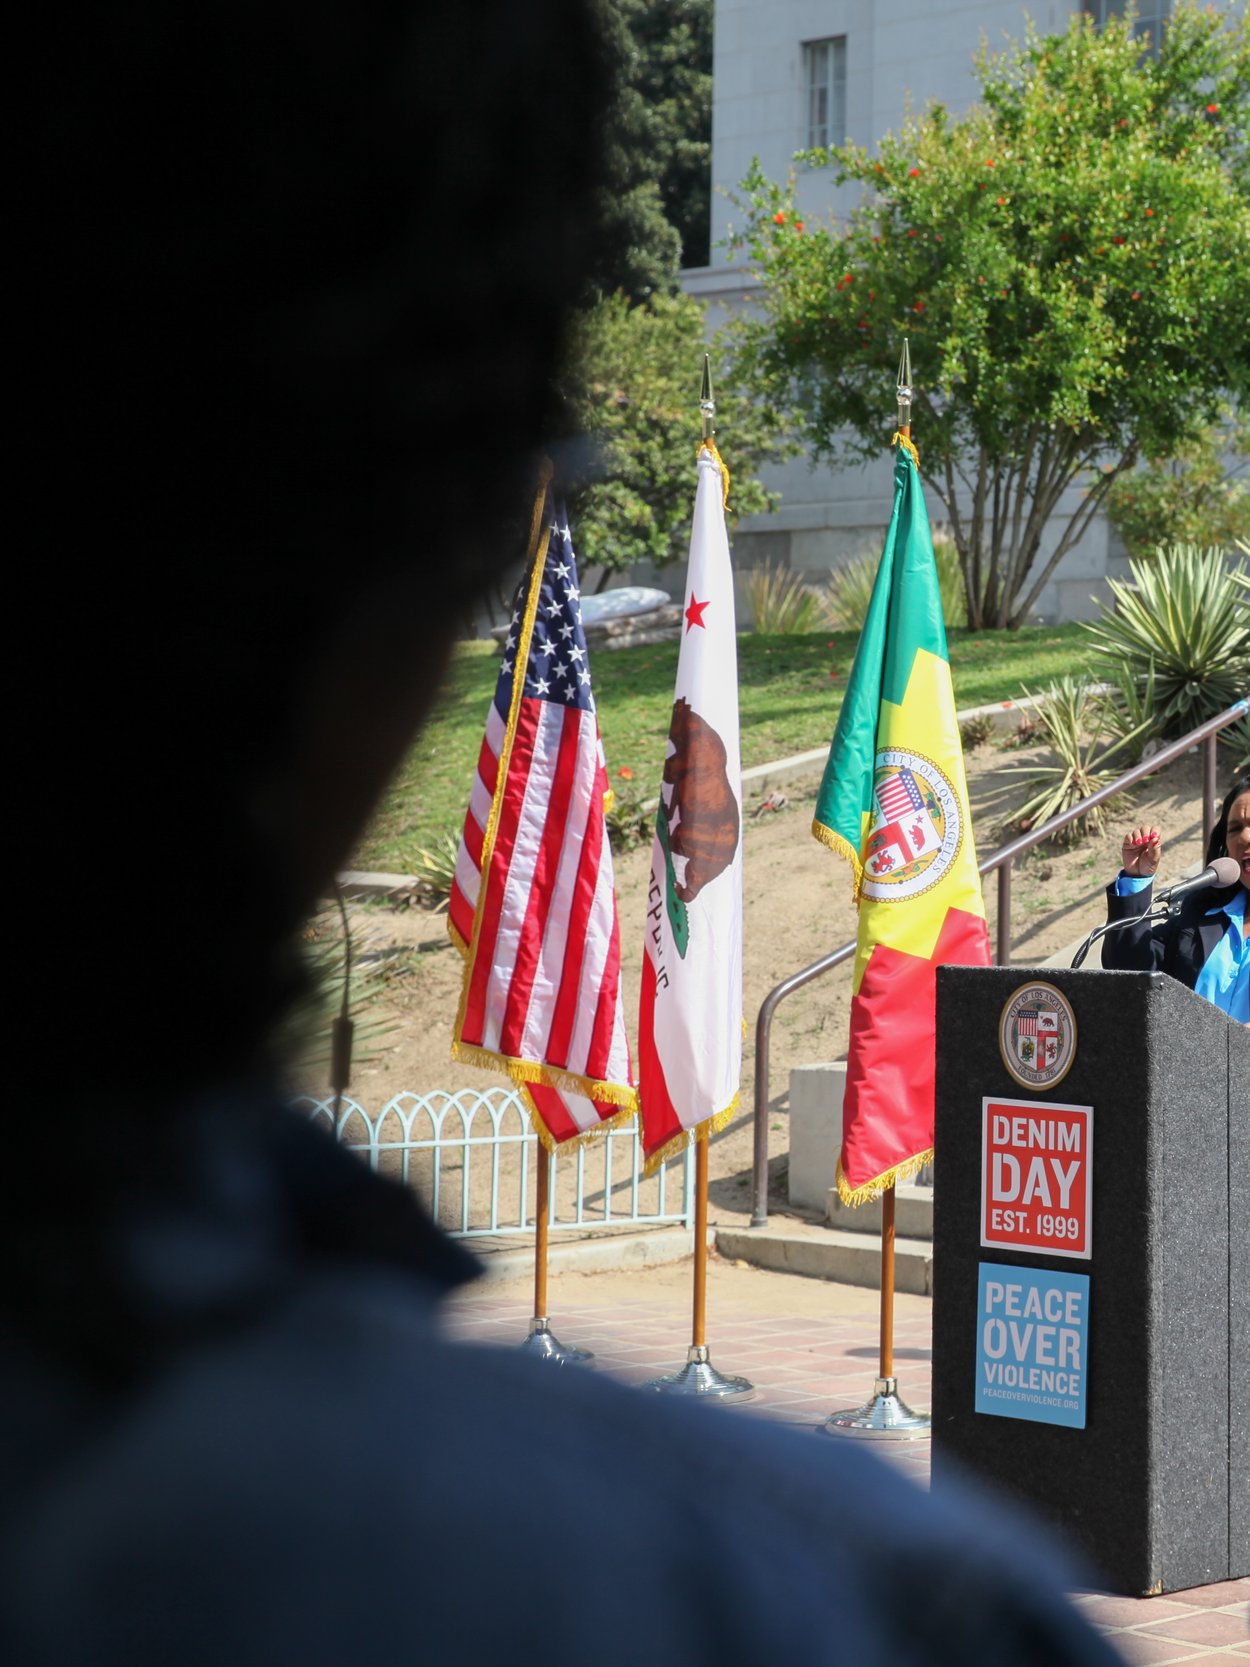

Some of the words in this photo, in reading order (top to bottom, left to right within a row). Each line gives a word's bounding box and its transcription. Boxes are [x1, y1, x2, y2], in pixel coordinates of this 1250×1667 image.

[883, 753, 917, 767] CITY
[919, 764, 934, 778] OF
[934, 780, 952, 806] LOS
[932, 811, 957, 875] ANGELES
[1031, 991, 1043, 999] LOS
[1044, 994, 1067, 1022] ANGELES
[992, 1115, 1081, 1153] DENIM
[992, 1152, 1082, 1209] DAY
[991, 1208, 1030, 1234] EST.
[1036, 1214, 1079, 1239] 1999
[985, 1281, 1082, 1326] PEACE
[983, 1318, 1081, 1370] OVER
[984, 1362, 1081, 1396] VIOLENCE
[983, 1388, 1079, 1410] PEACEOVERVIOLENCE.ORG
